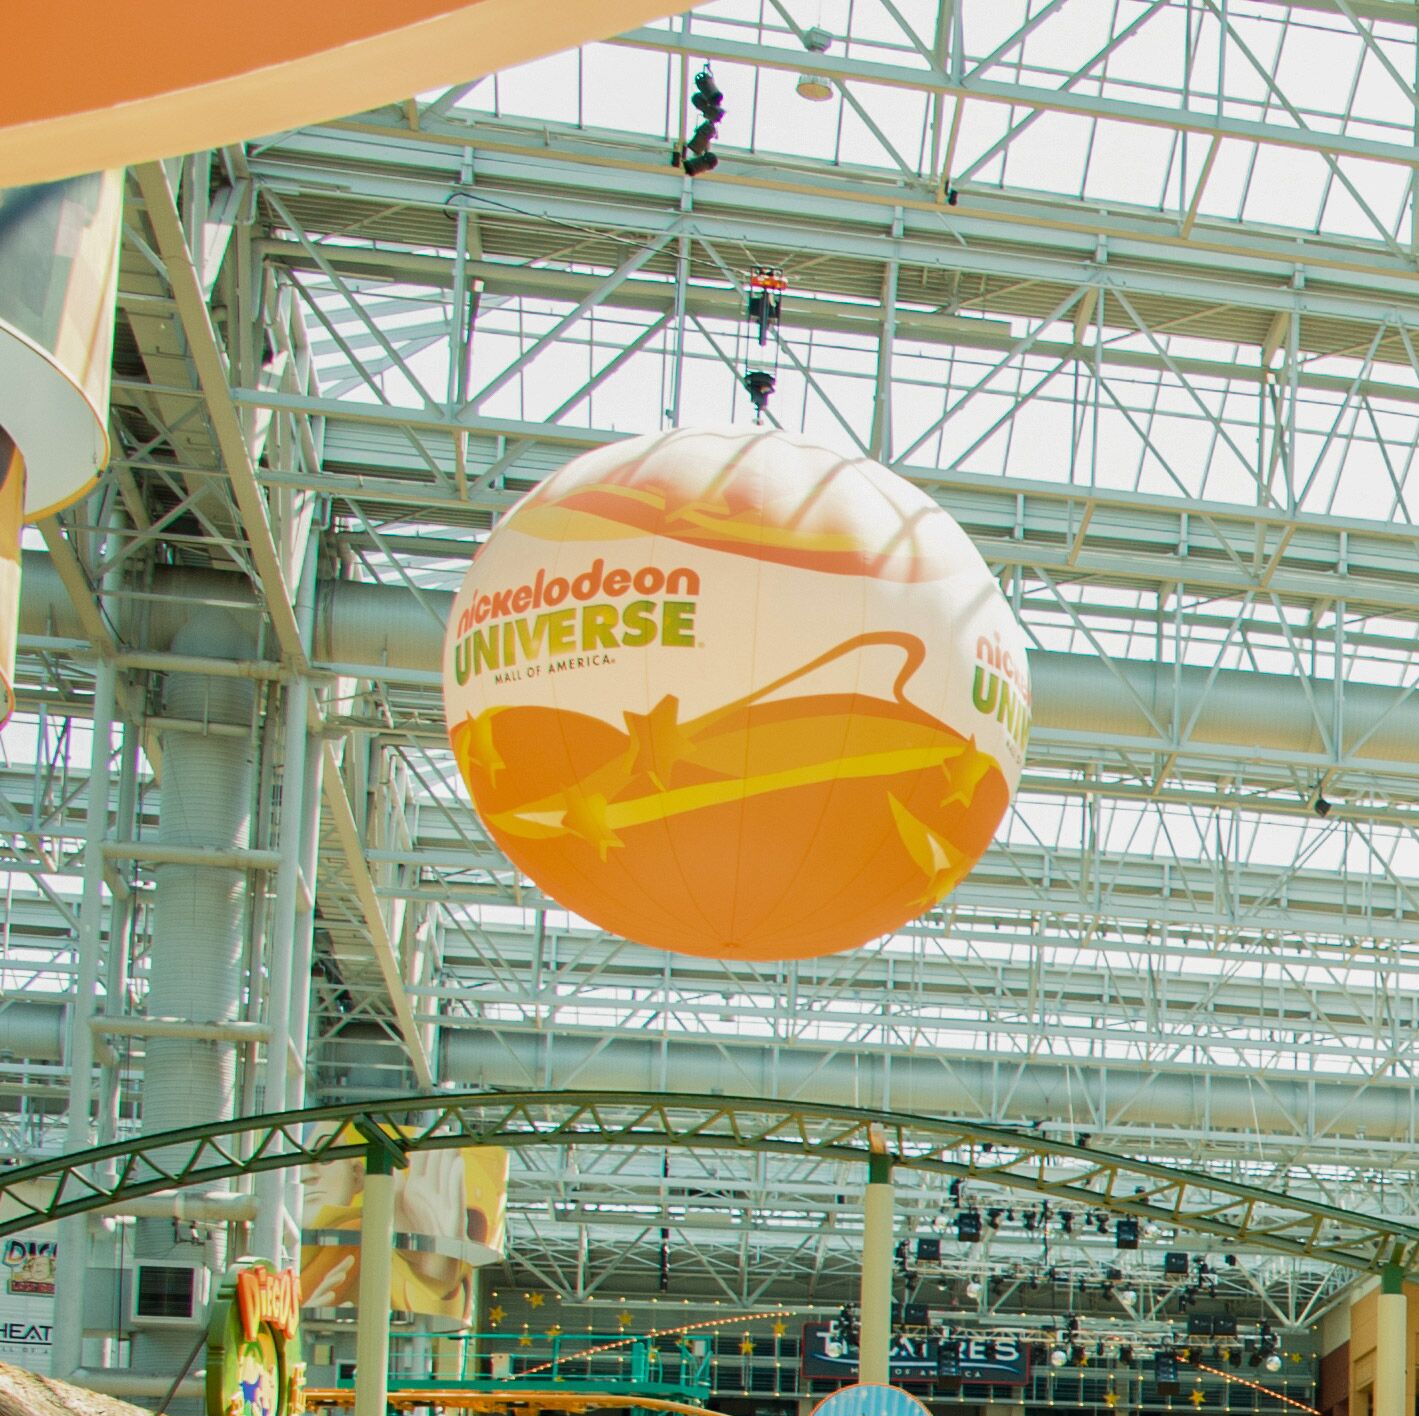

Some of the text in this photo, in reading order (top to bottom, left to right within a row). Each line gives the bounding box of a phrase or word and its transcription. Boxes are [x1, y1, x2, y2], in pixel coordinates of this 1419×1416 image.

[457, 558, 700, 639] nickelodeon
[455, 600, 697, 687] UNIVERSE
[494, 654, 610, 685] MALL OF AMERICA
[920, 1368, 982, 1379] AMCA
